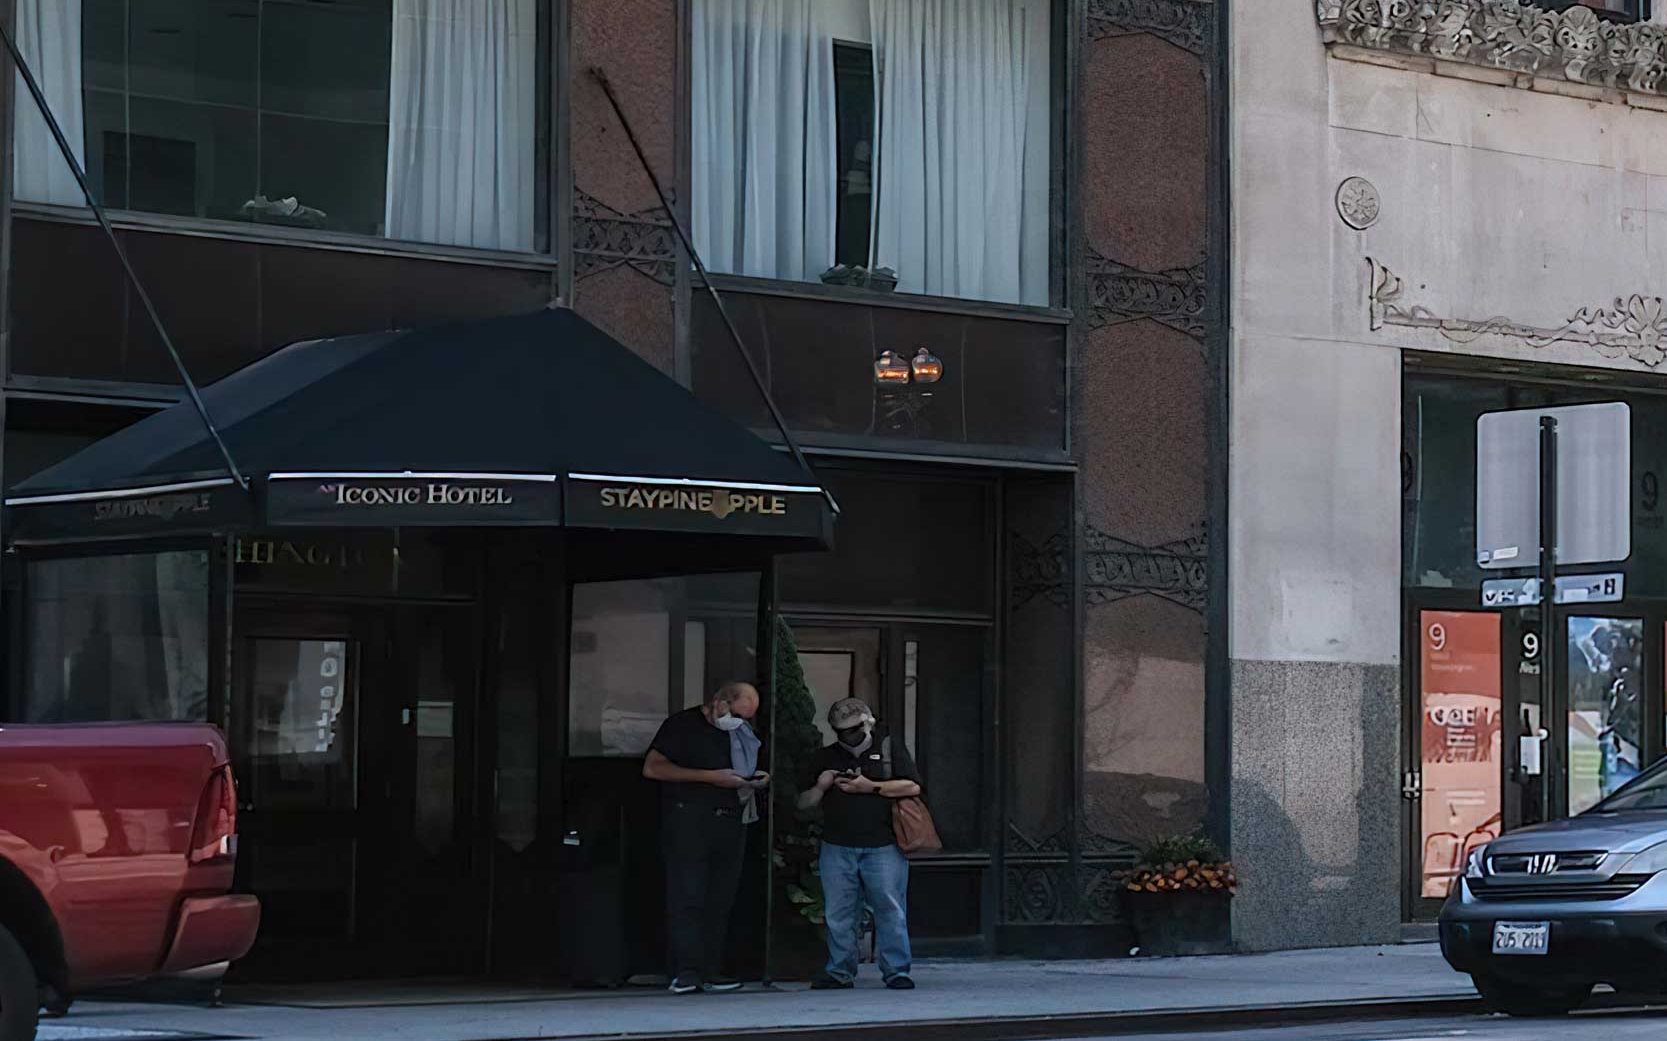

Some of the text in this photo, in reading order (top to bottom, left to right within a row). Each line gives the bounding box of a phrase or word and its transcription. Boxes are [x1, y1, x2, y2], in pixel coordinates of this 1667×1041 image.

[335, 483, 420, 504] ICONIC
[427, 484, 513, 505] HOTEL
[1428, 622, 1447, 651] 9
[1523, 633, 1539, 658] 9
